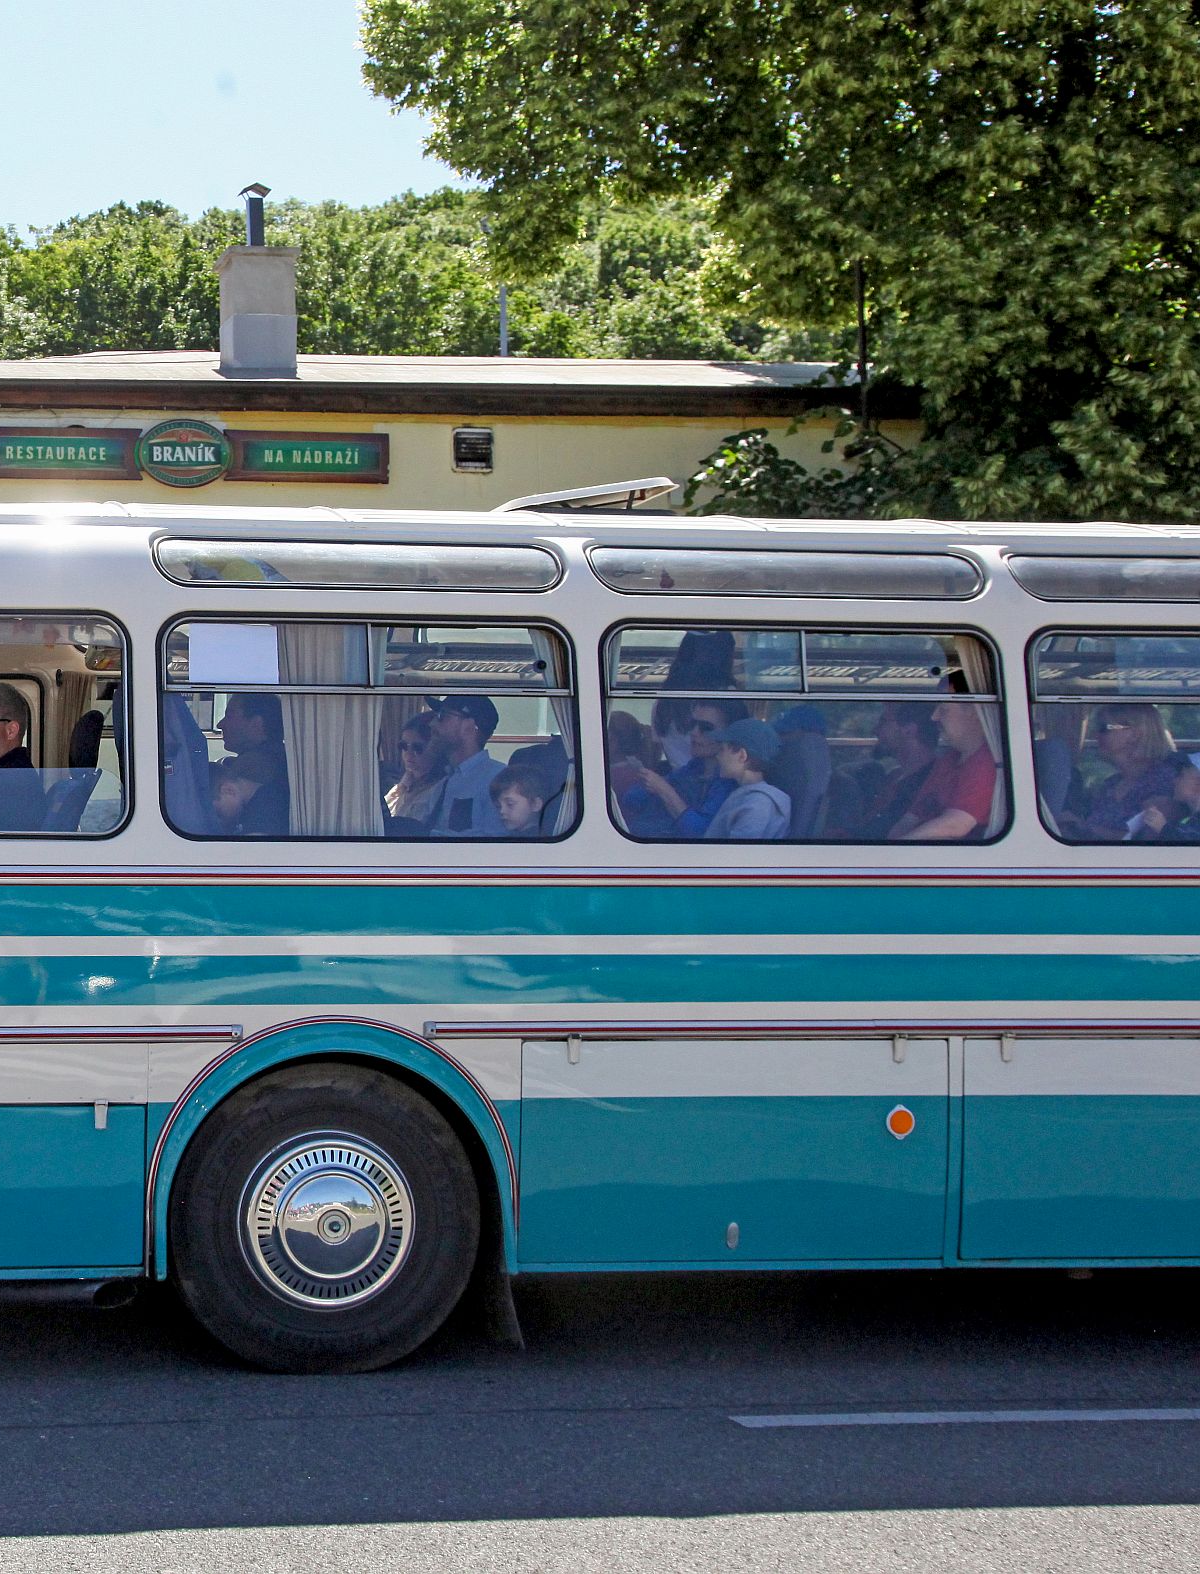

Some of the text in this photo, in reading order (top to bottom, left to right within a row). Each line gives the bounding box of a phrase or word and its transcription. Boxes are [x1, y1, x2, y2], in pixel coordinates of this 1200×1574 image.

[5, 446, 106, 461] RESTAURACE
[153, 443, 216, 462] BRANÍK
[264, 448, 359, 464] NA NÁDRAŽÍ
